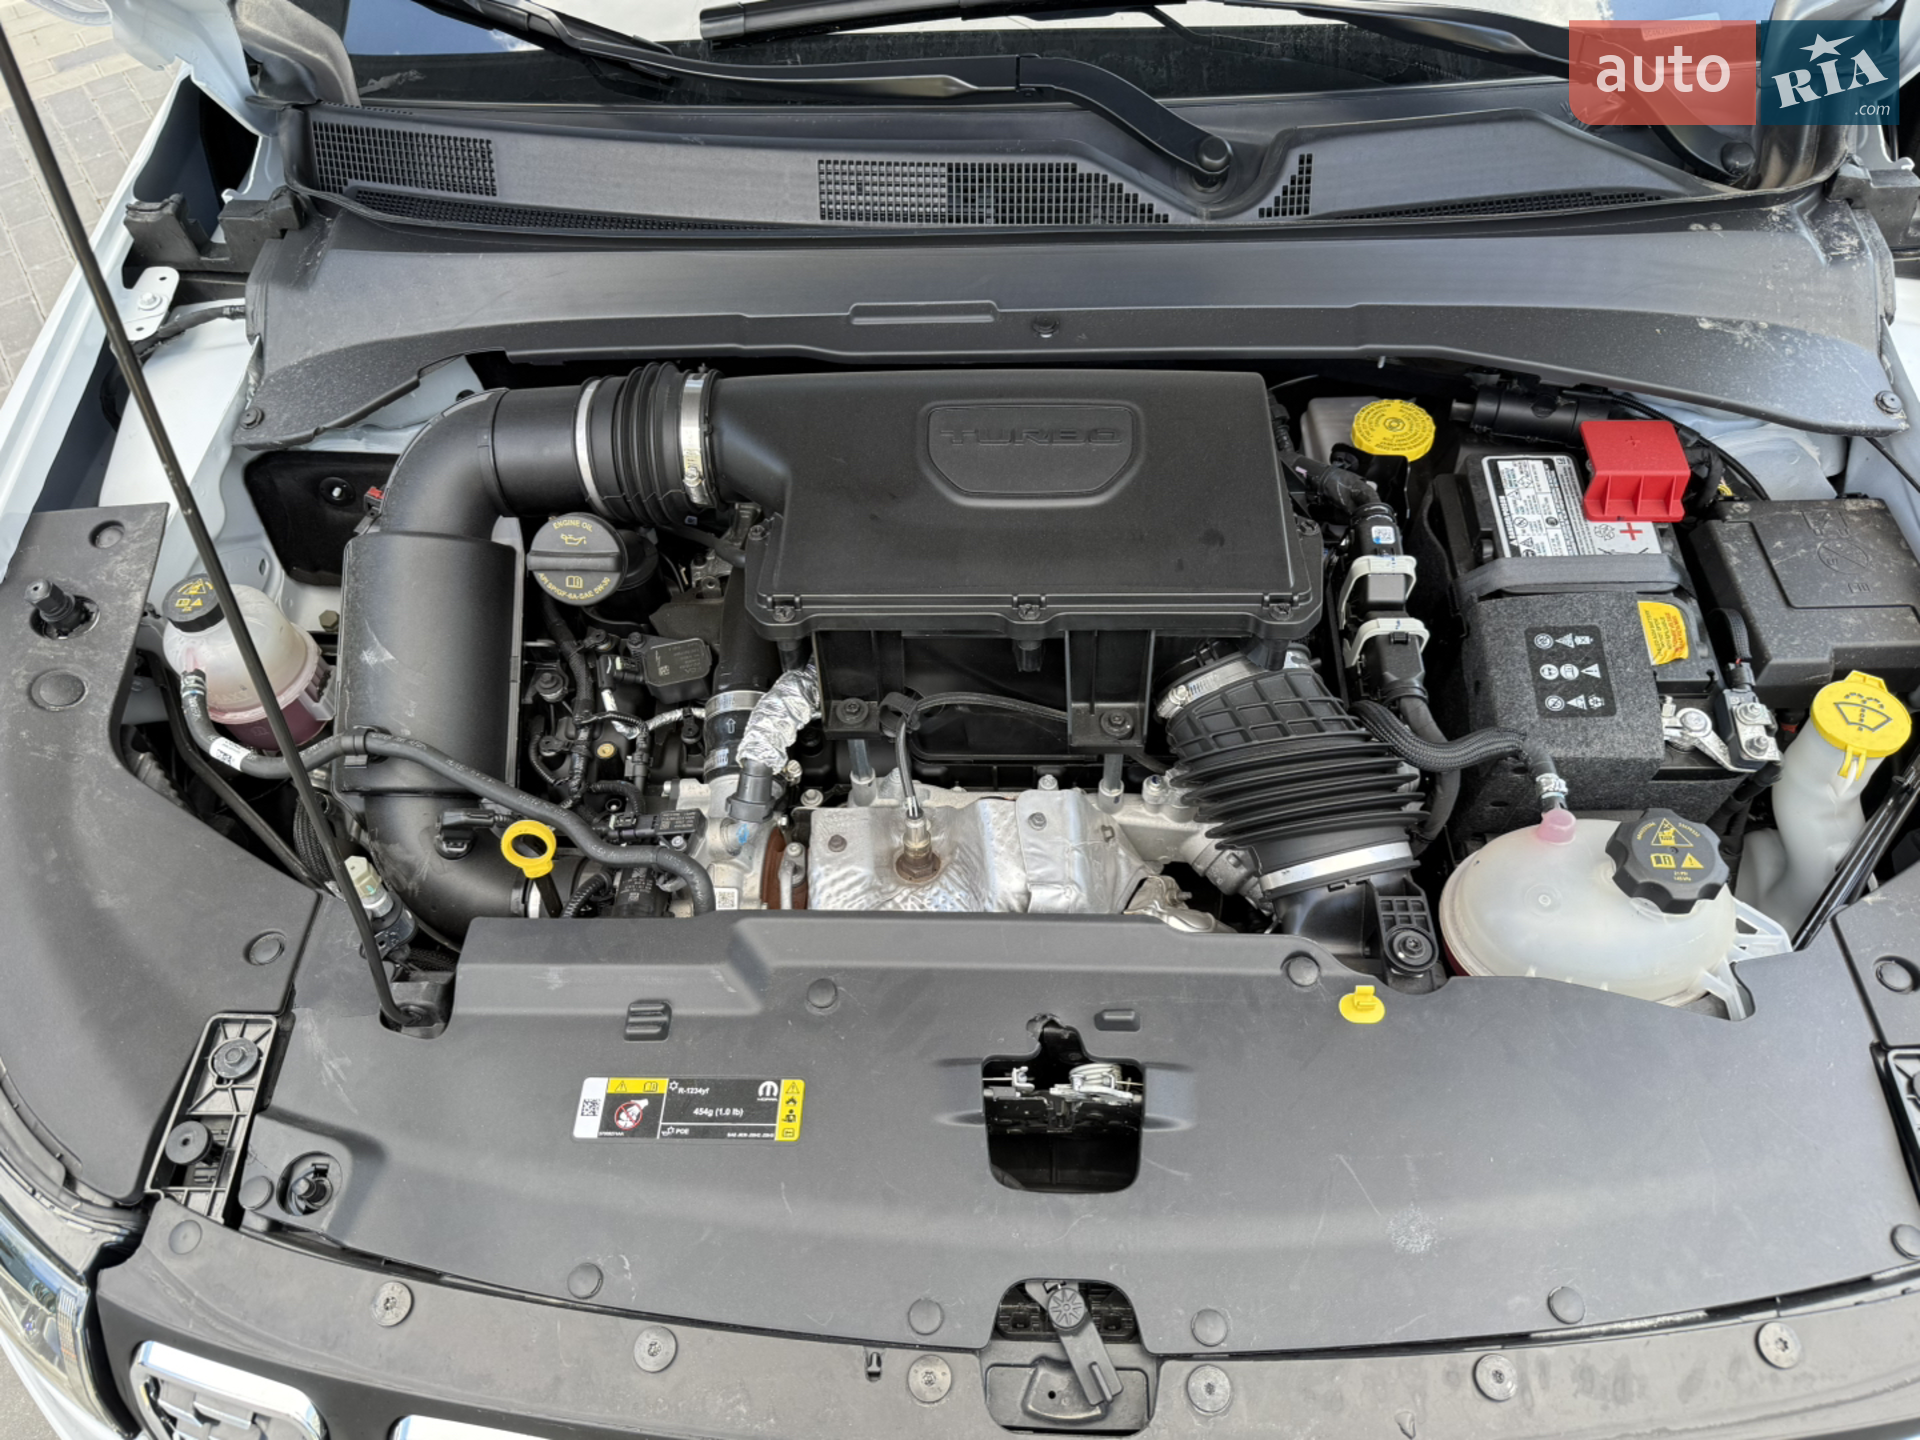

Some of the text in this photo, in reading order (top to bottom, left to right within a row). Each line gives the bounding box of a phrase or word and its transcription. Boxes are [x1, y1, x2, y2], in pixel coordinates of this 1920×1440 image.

[940, 428, 1123, 446] TURBO
[552, 519, 593, 533] ENGINE OIL
[678, 1087, 710, 1096] R-1234yf
[693, 1107, 744, 1117] 454g (1.0 lb)
